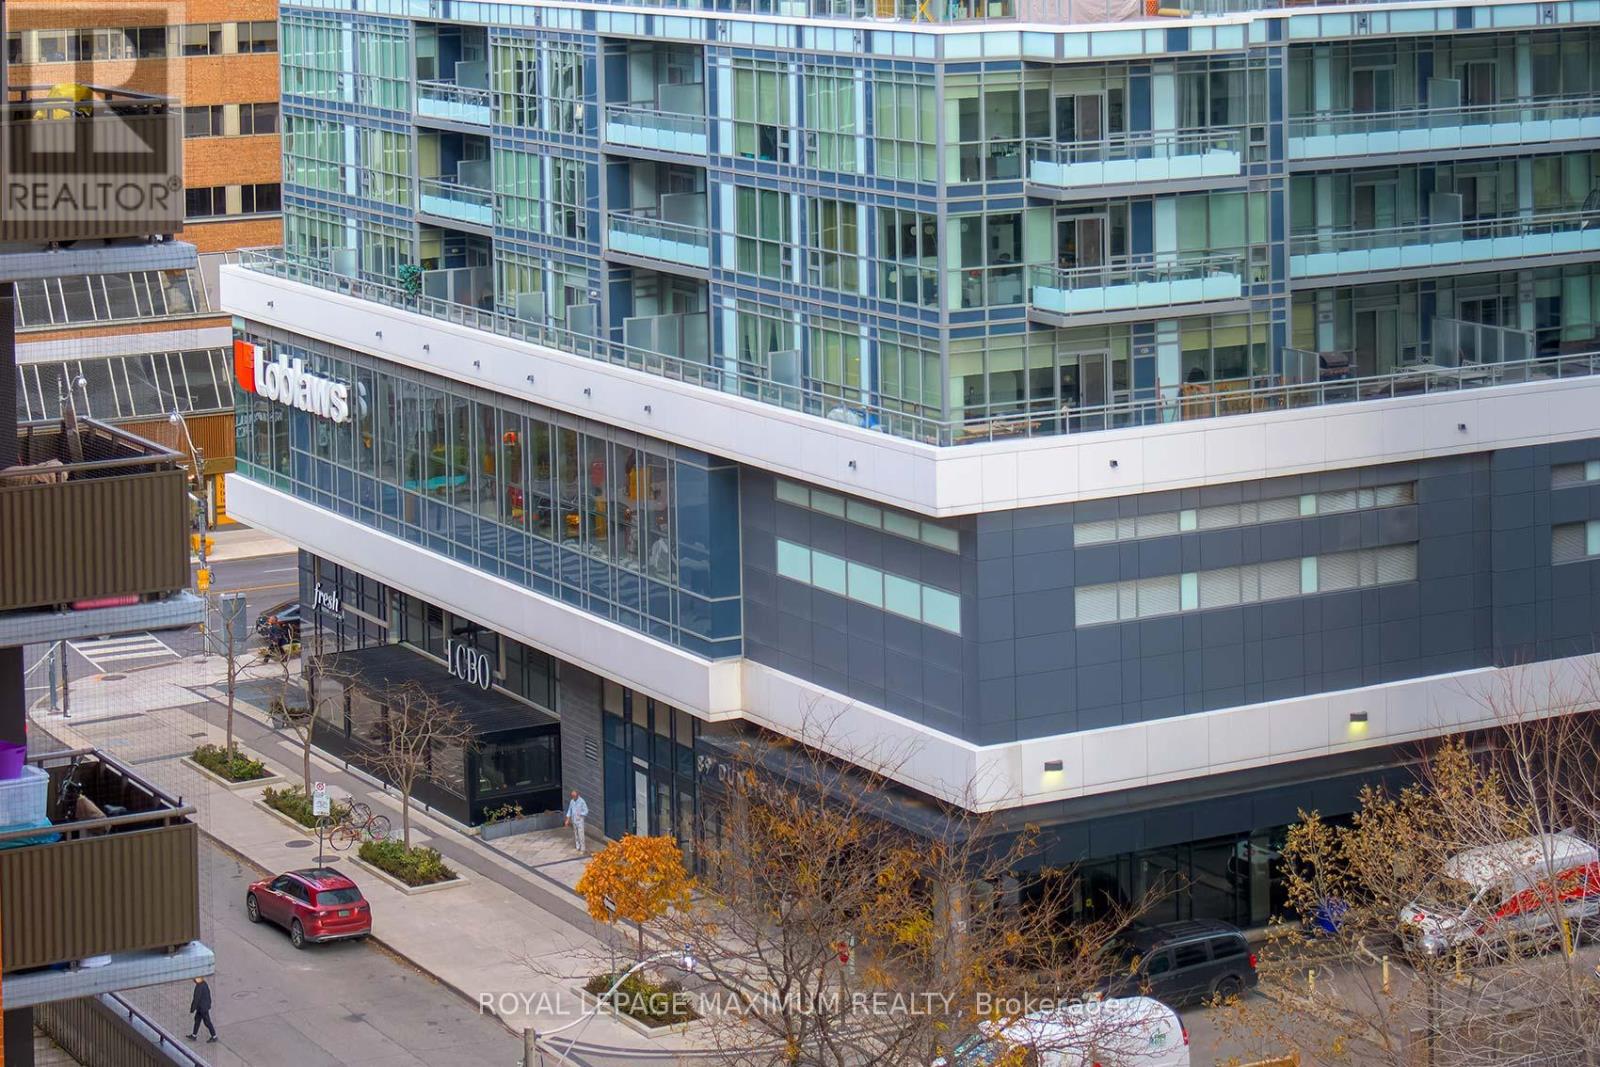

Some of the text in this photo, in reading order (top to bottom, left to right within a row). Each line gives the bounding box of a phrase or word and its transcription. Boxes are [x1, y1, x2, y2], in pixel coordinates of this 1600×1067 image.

[253, 344, 349, 423] Loblaws
[311, 582, 339, 612] fresh
[447, 638, 490, 690] LCBO
